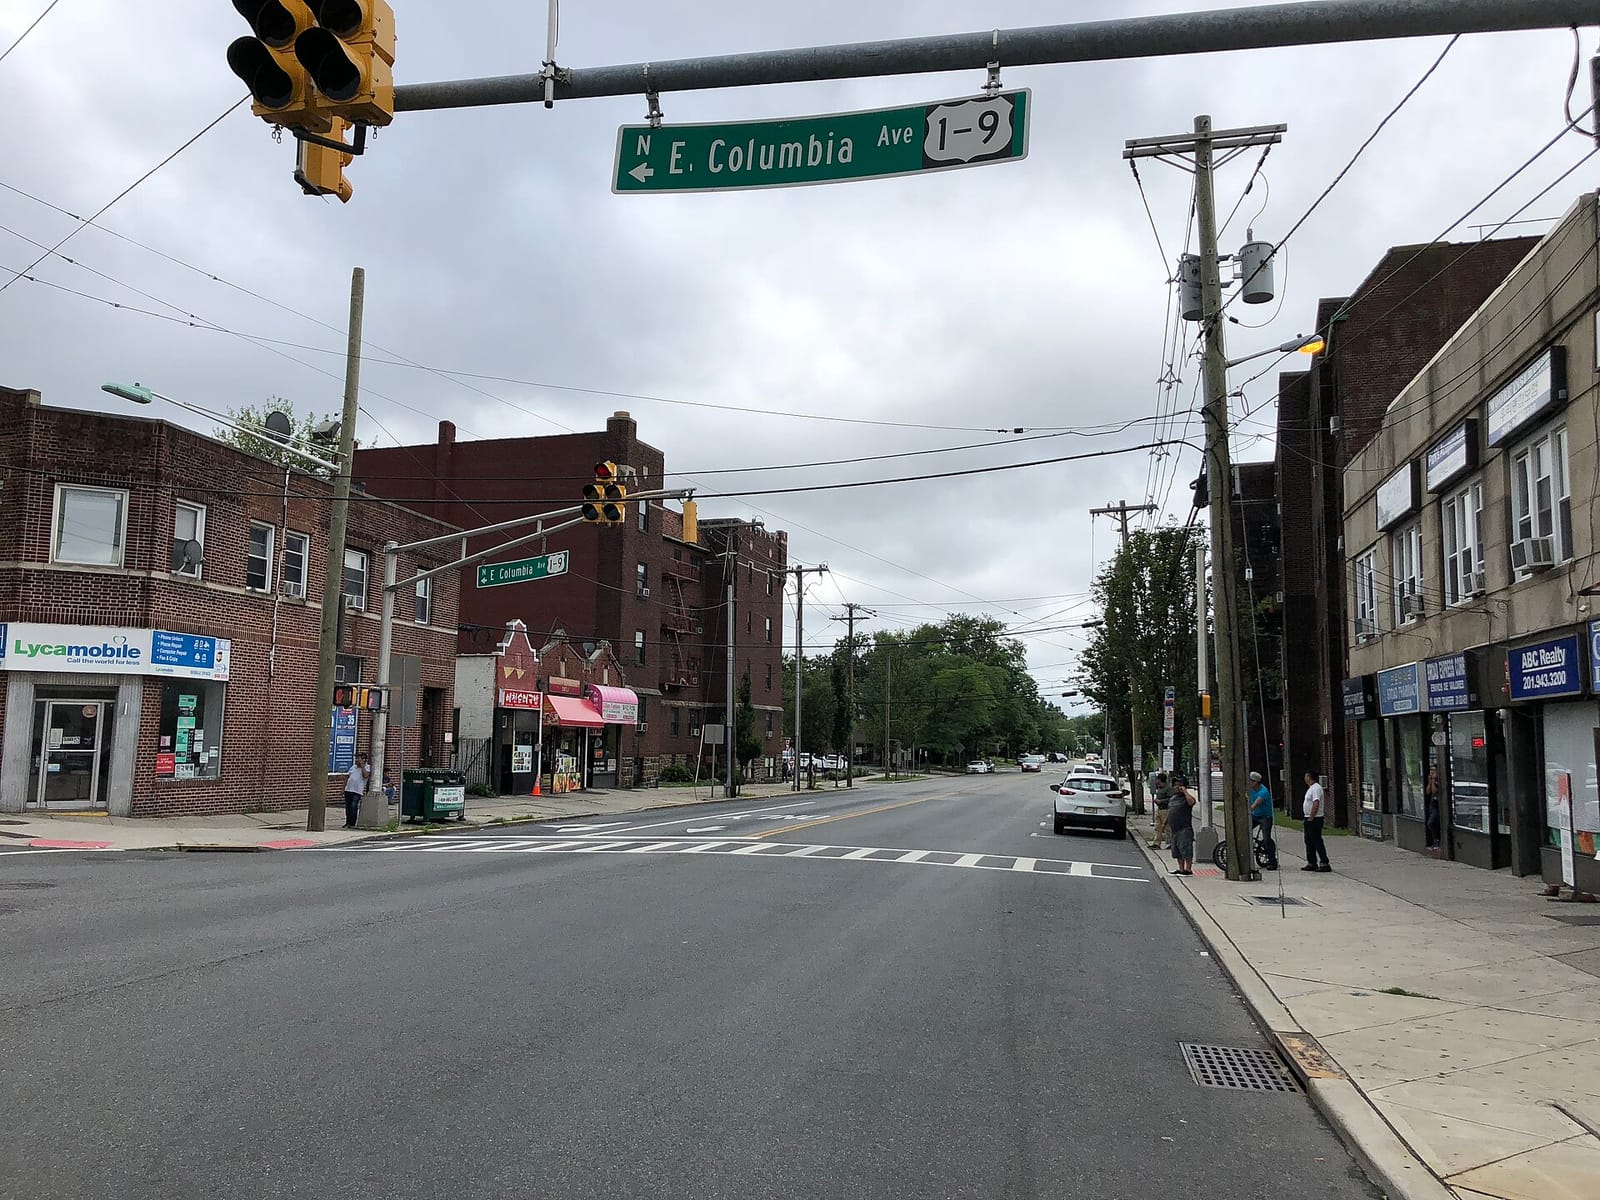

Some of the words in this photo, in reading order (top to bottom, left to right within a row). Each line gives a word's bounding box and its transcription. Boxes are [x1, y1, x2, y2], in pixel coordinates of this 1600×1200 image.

[636, 135, 651, 156] N
[708, 131, 854, 174] Columbia
[877, 125, 913, 147] Ave
[938, 110, 1000, 151] 1-9
[481, 568, 487, 576] N
[490, 569, 495, 581] E
[500, 564, 534, 580] Columbia
[537, 561, 546, 569] Ave
[14, 639, 141, 658] Lycamobile
[1522, 651, 1539, 669] ABC
[1539, 646, 1566, 666] Realty
[1522, 670, 1566, 690] 201.943.3200
